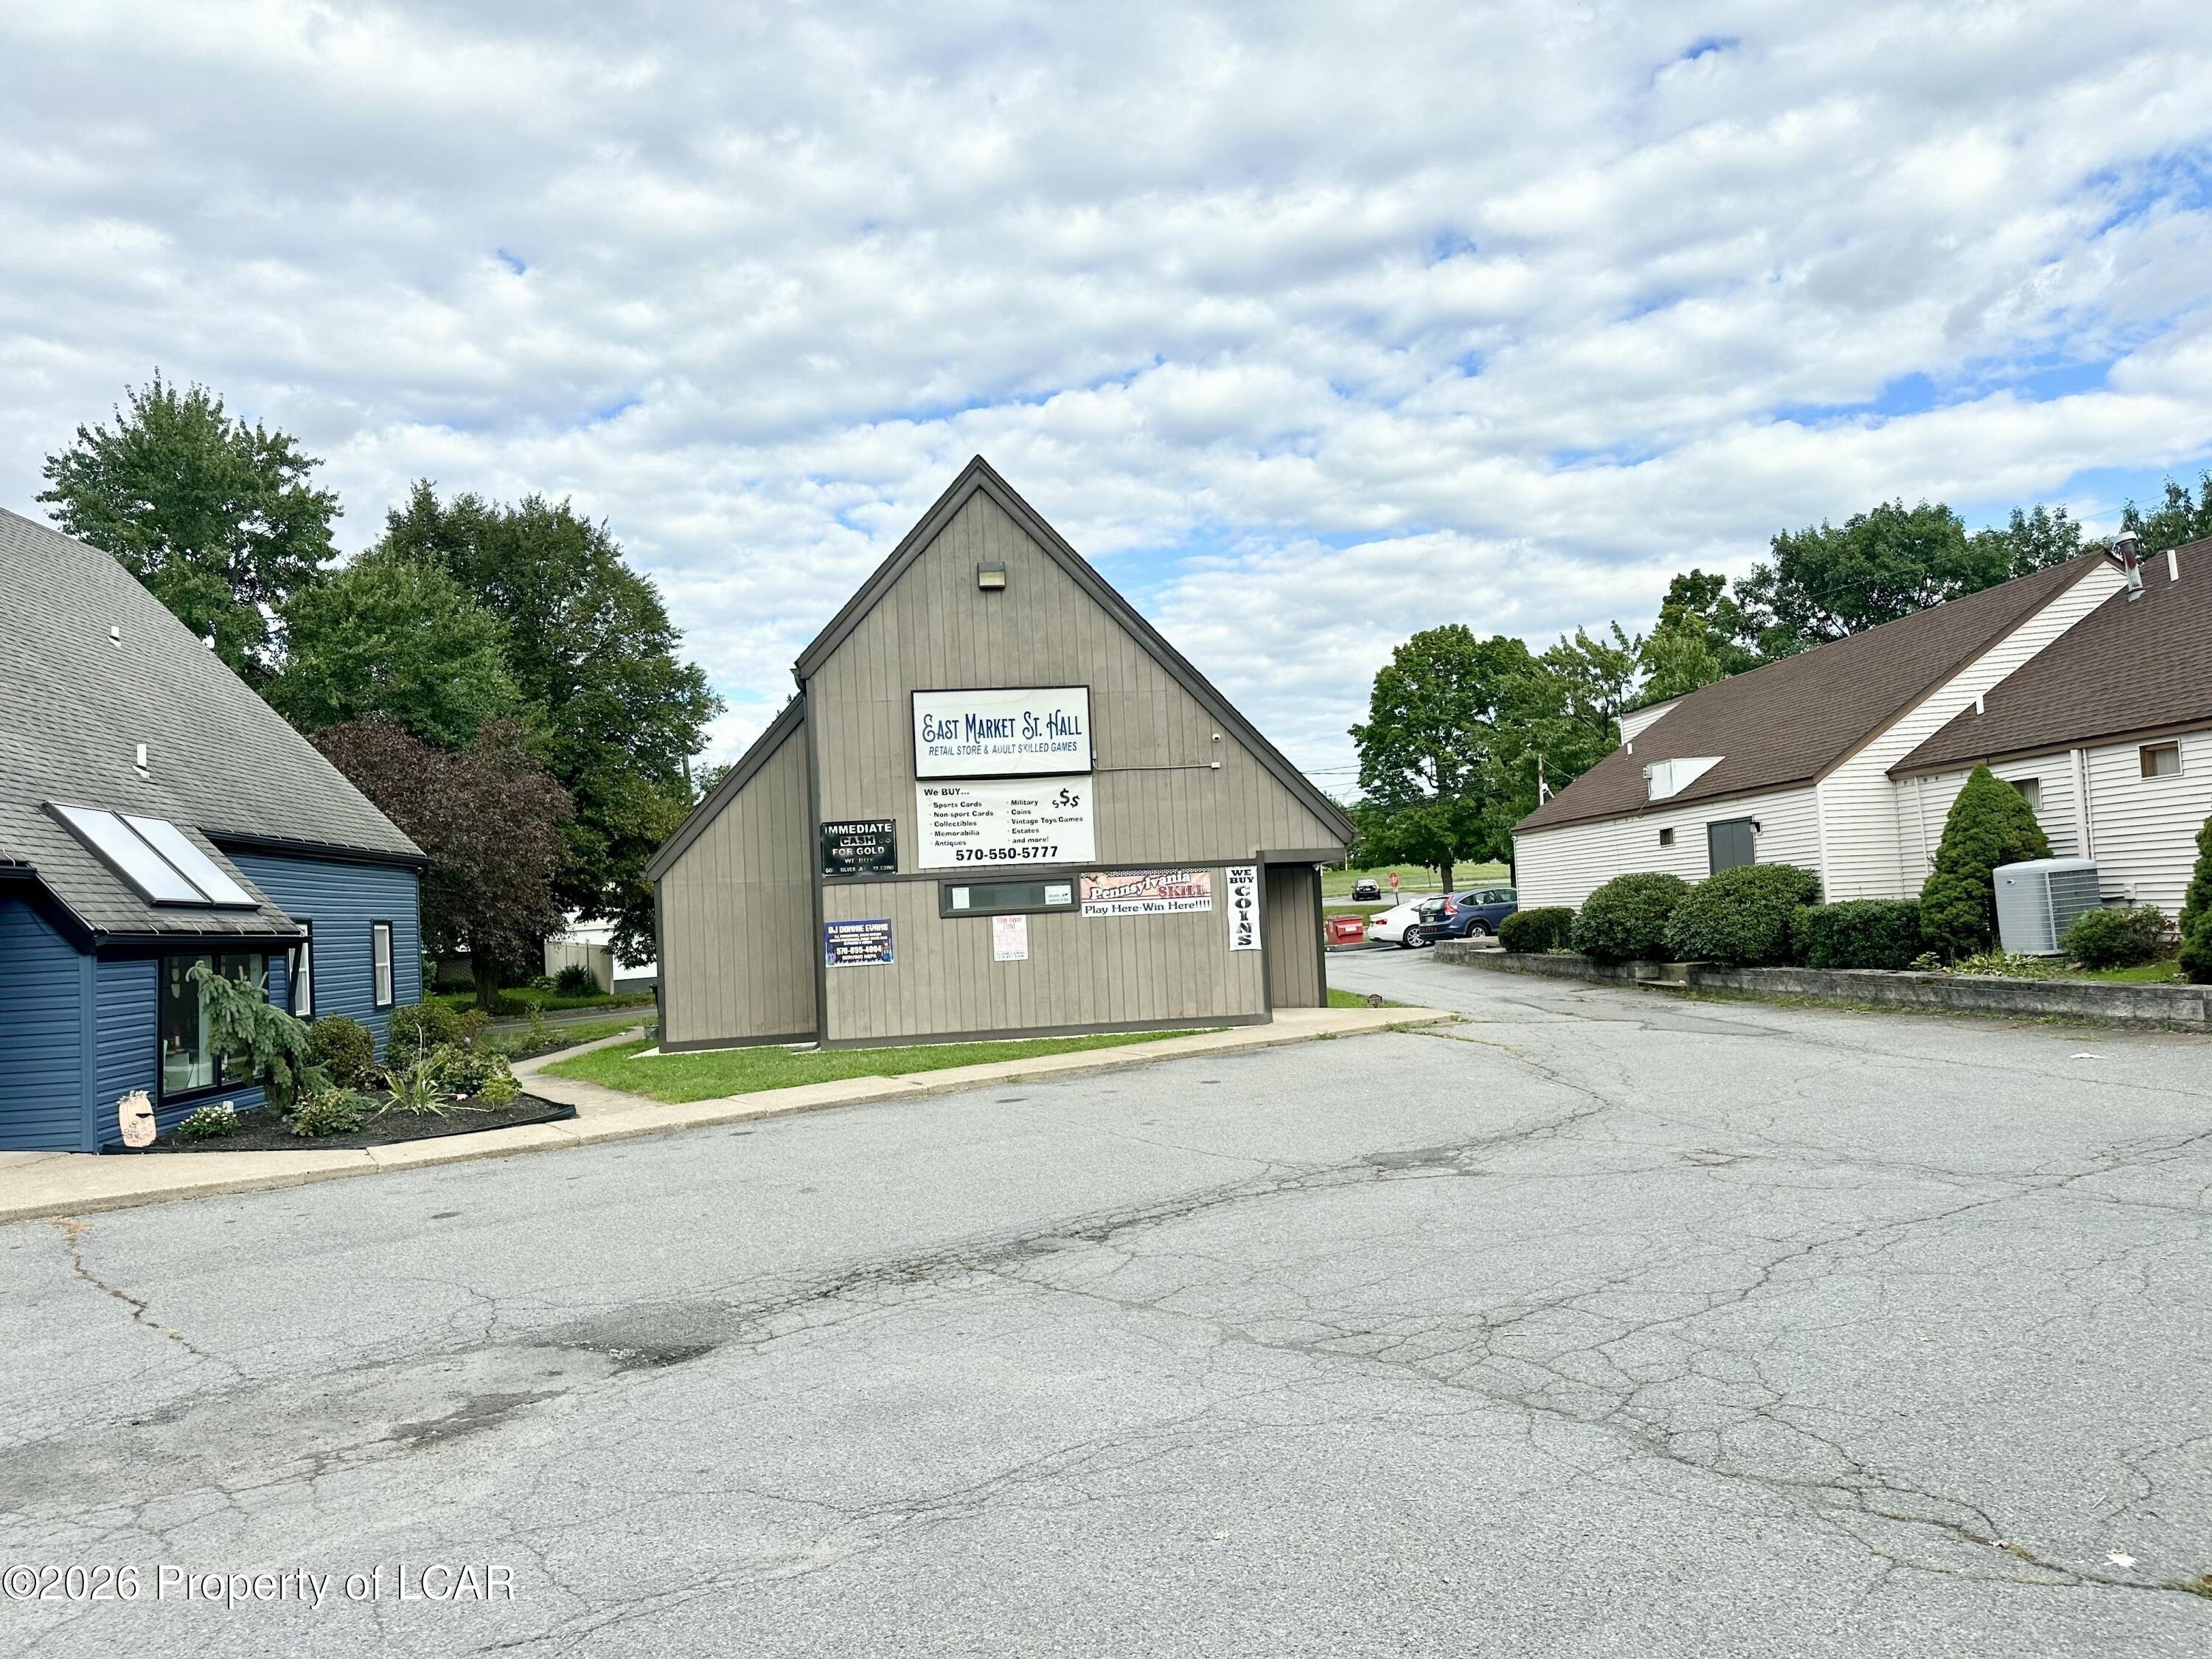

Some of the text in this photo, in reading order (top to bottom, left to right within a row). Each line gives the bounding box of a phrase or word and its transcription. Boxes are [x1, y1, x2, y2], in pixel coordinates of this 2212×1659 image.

[965, 713, 1016, 743] MARKET
[1046, 709, 1082, 740] HALL
[929, 742, 1077, 756] RETAIL STORE & ADULT SKILLED GAMES
[933, 801, 959, 810] Sports
[825, 823, 892, 834] IMMEDIATE
[841, 835, 874, 845] CASH
[856, 846, 885, 855] GOLD
[956, 846, 1058, 861] 570-550-5777
[1090, 870, 1192, 900] Pennsylvania
[1158, 883, 1206, 898] SKILL
[1085, 904, 1108, 914] Play
[1168, 900, 1211, 911] Here!!!!
[839, 924, 864, 933] DONNIE
[865, 923, 888, 932] EVANS
